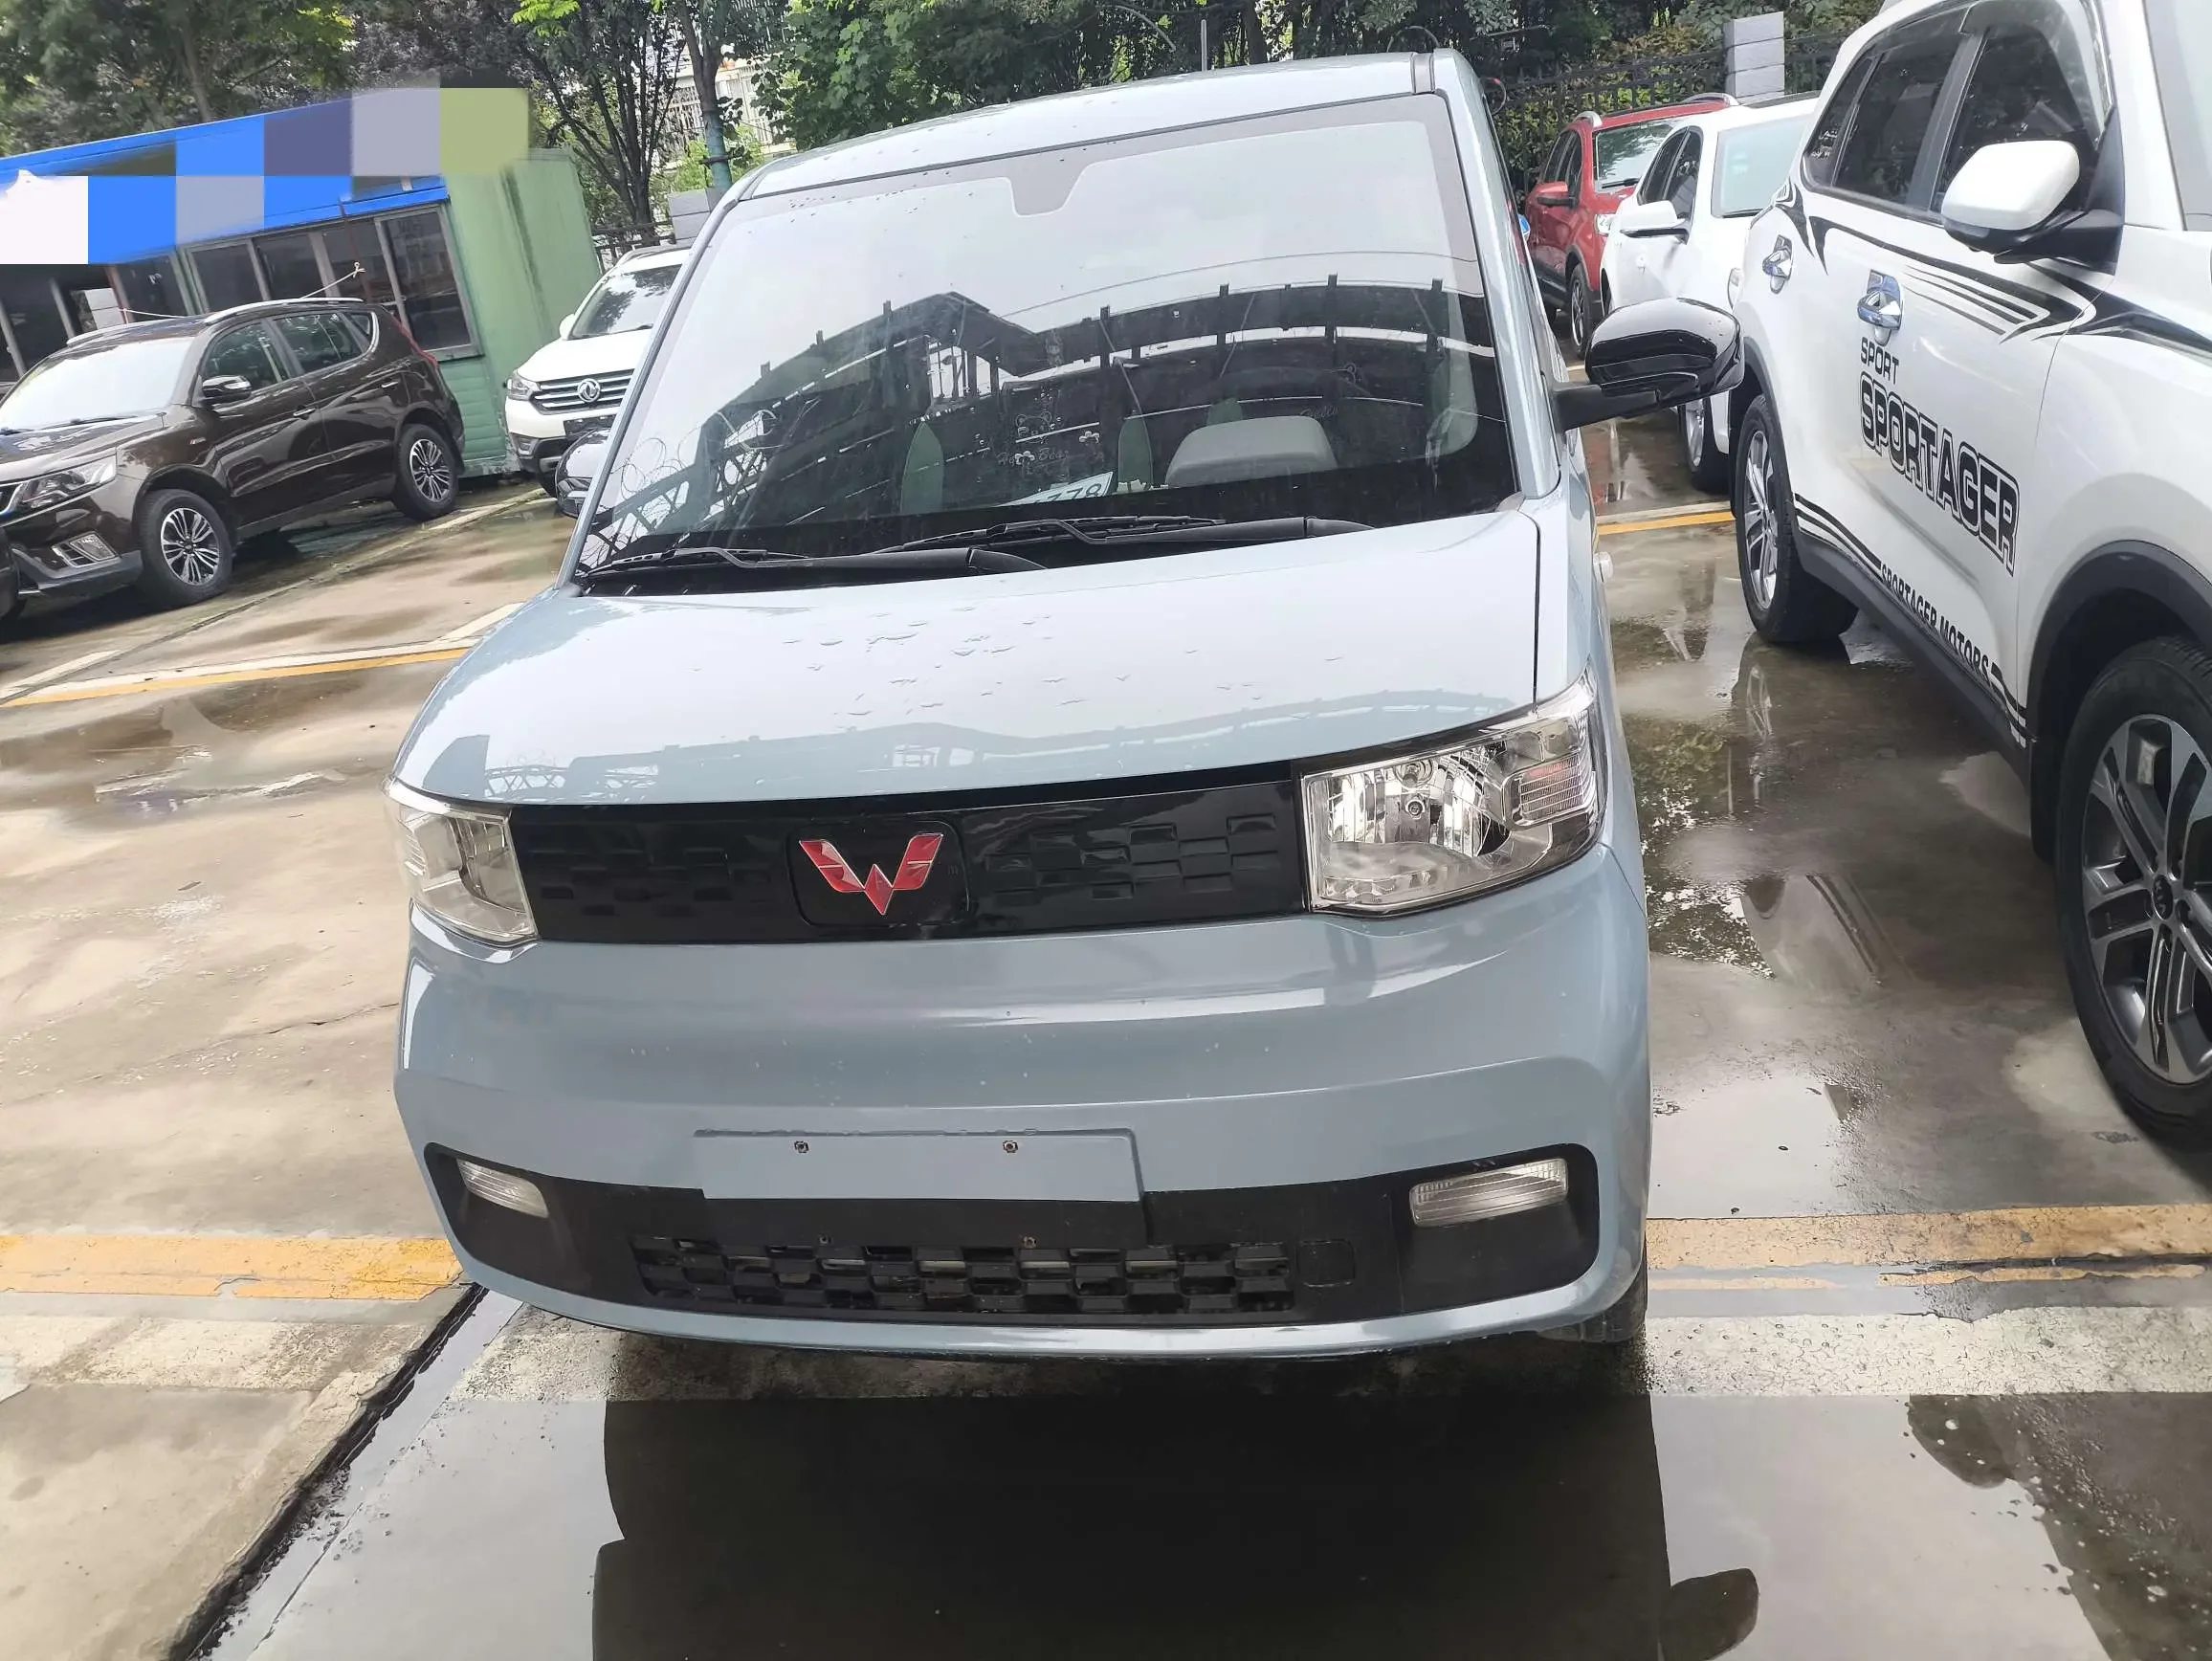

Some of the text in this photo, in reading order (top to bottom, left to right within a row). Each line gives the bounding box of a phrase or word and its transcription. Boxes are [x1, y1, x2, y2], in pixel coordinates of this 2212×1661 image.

[1861, 337, 1899, 385] SPORT
[1860, 370, 2021, 577] SPORTAGER
[1939, 615, 1990, 683] MOTORS
